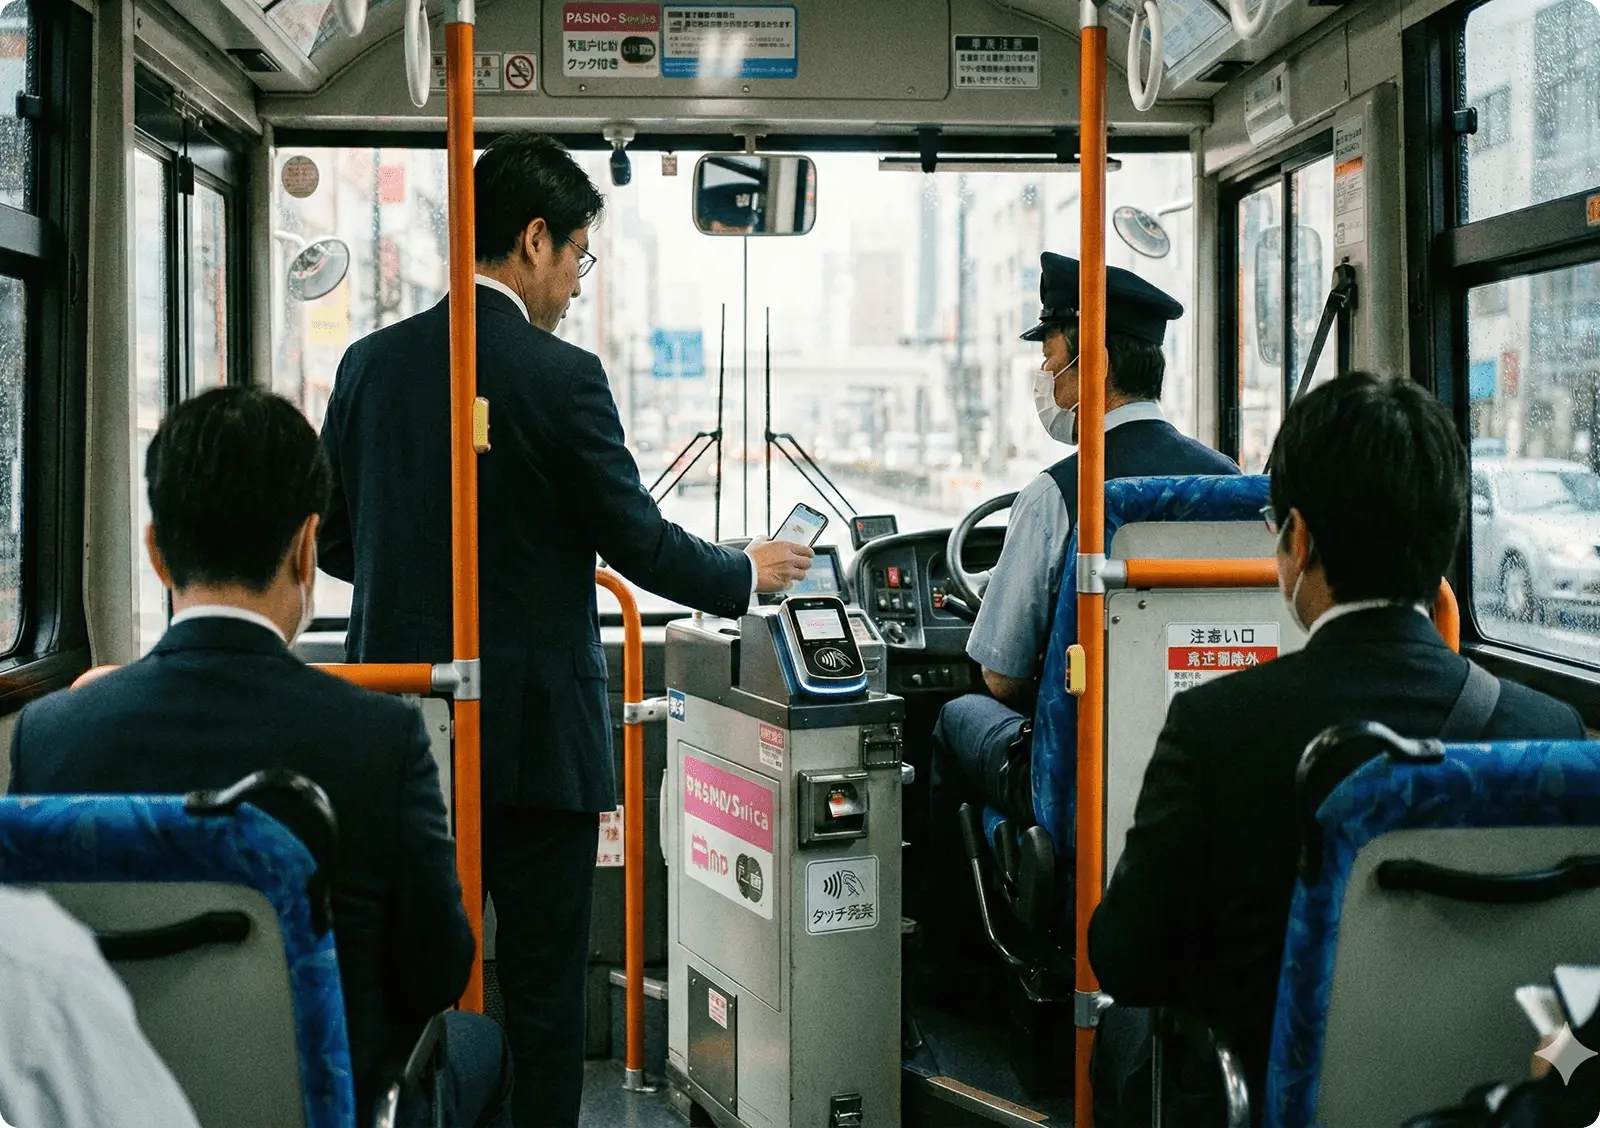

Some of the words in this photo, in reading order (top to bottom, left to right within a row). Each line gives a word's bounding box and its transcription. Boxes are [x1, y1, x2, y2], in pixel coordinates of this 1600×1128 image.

[567, 58, 619, 70] クック付き
